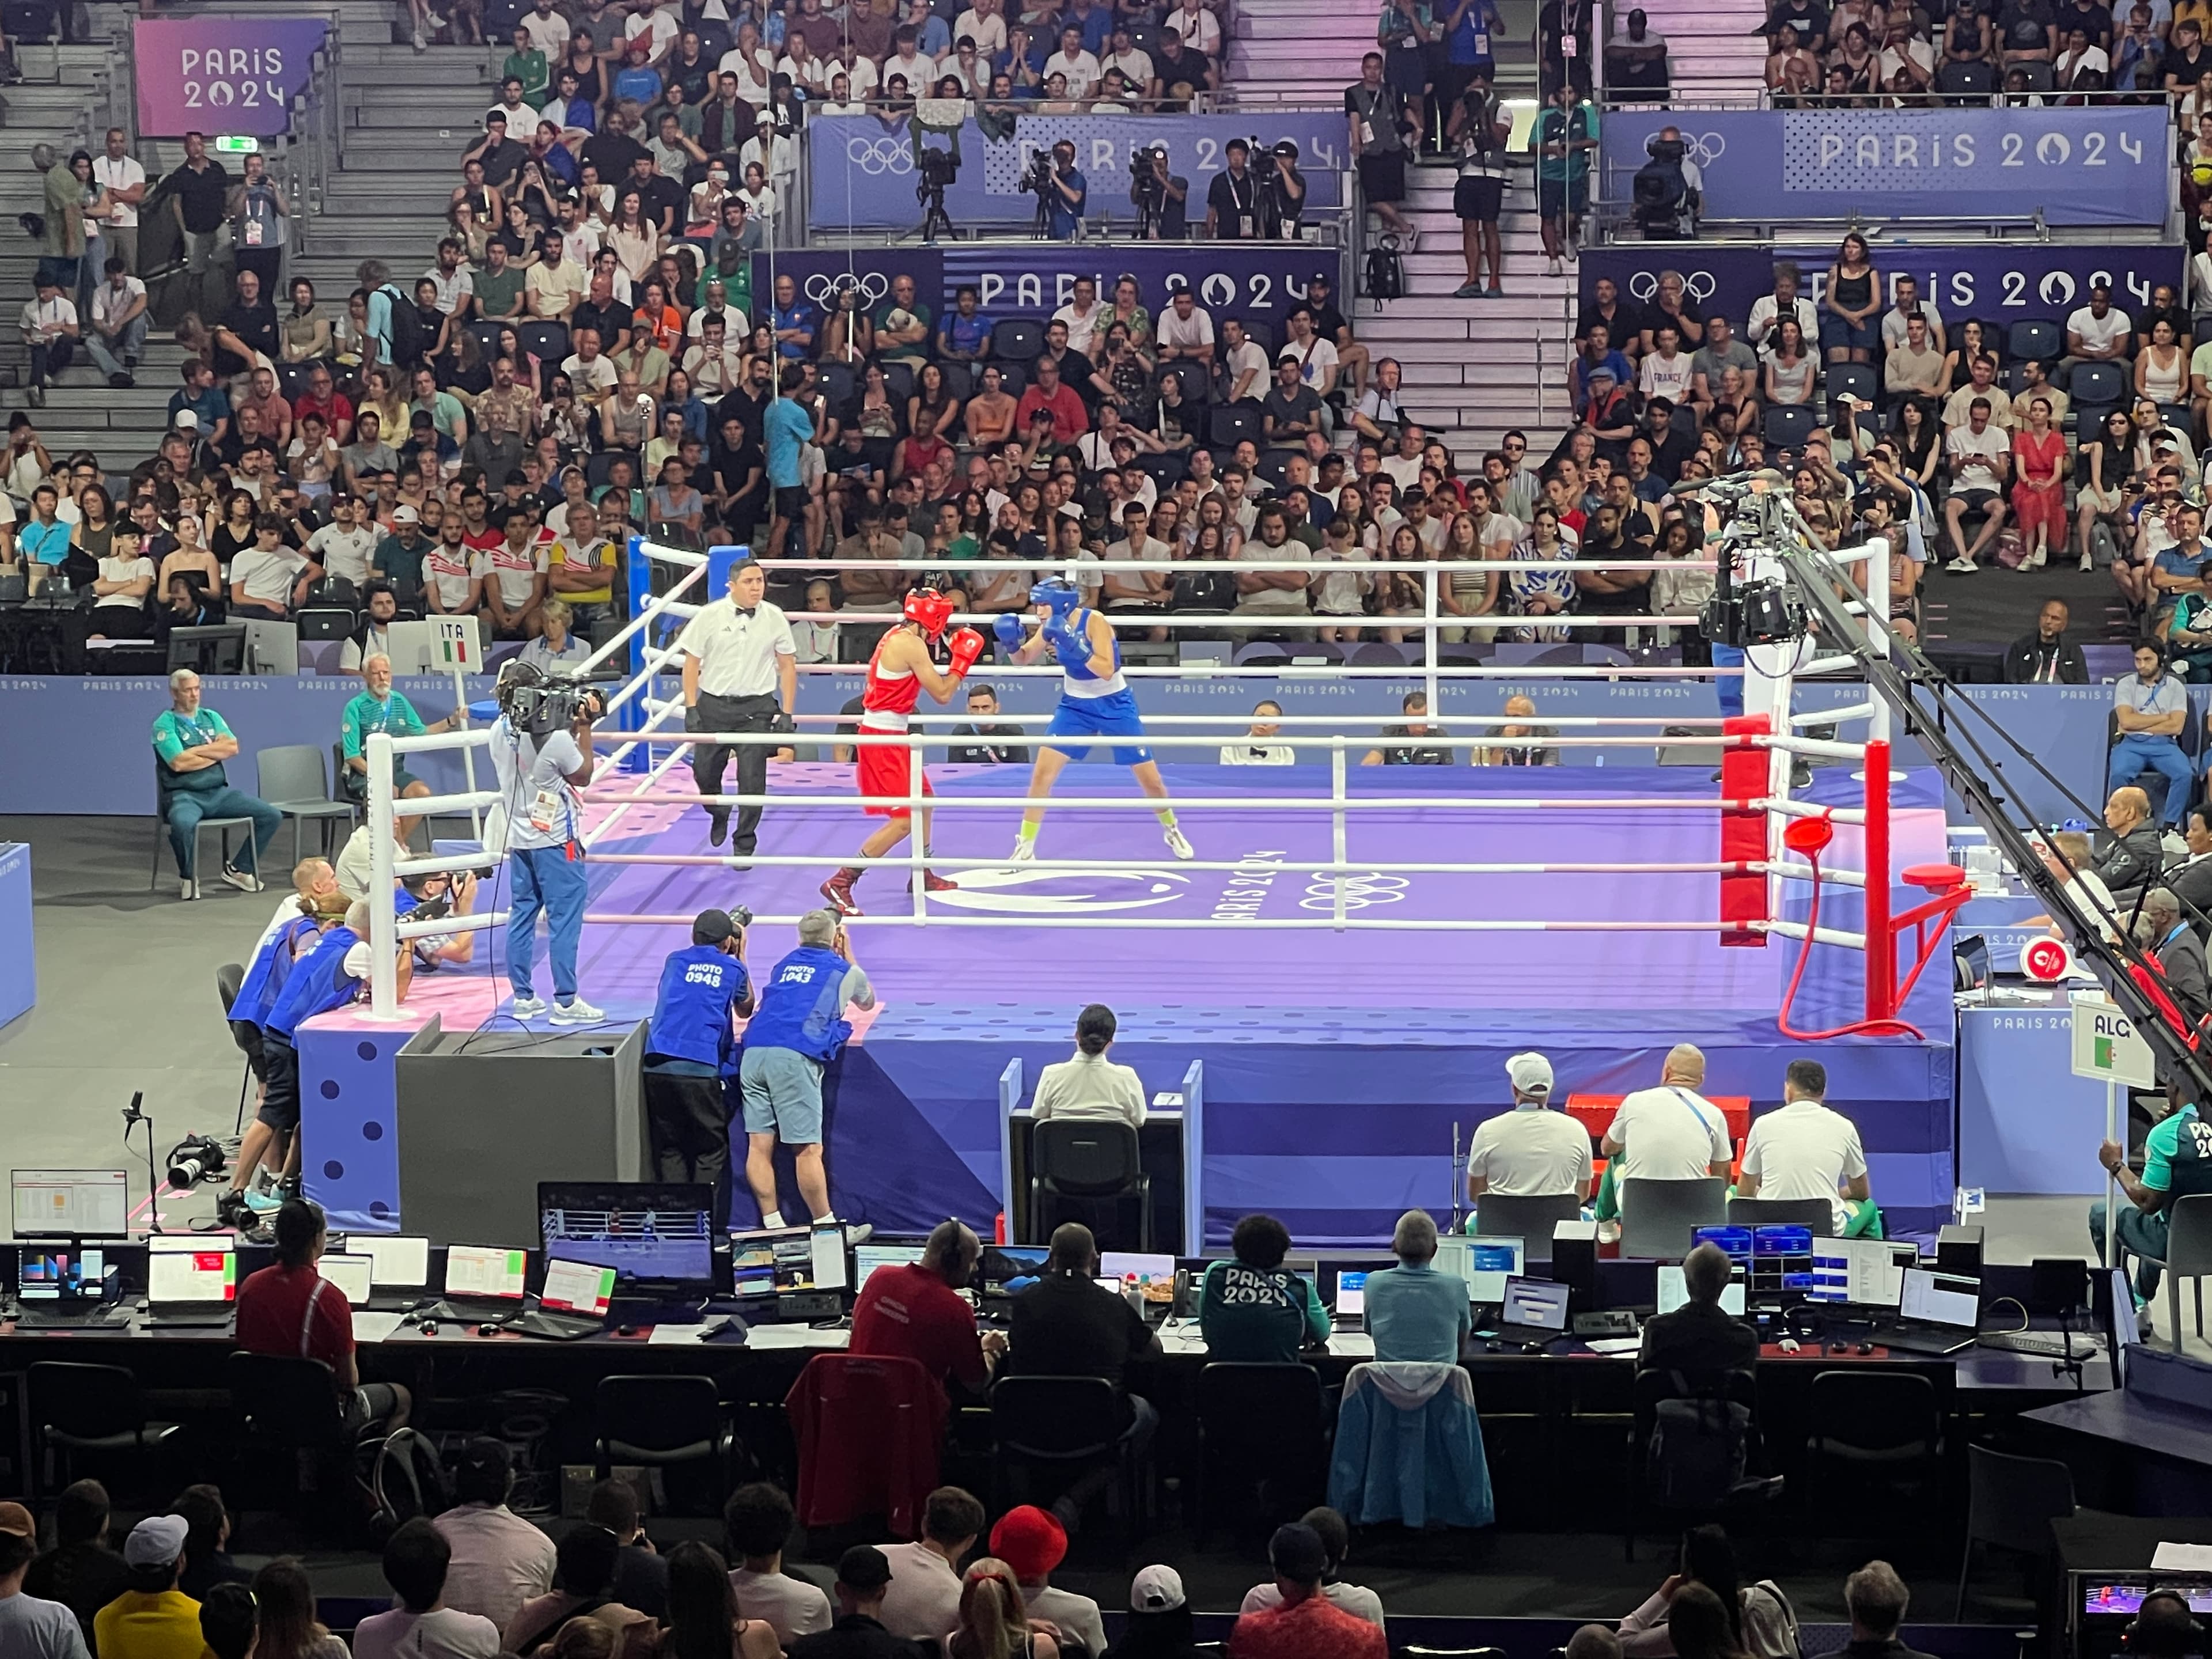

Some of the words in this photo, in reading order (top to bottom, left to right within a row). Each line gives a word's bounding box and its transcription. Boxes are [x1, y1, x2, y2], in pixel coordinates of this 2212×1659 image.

[184, 81, 283, 107] 2024
[2001, 132, 2142, 166] 2024
[441, 624, 464, 639] ITA
[199, 681, 228, 690] ARIS
[1440, 687, 1466, 696] 024
[1834, 690, 1865, 699] PARI
[1211, 889, 1267, 919] ARIS
[688, 964, 723, 975] PHOTO
[783, 965, 816, 974] PHOTO
[685, 971, 721, 987] 0948
[779, 972, 812, 983] 1043
[1223, 1286, 1287, 1306] 2024
